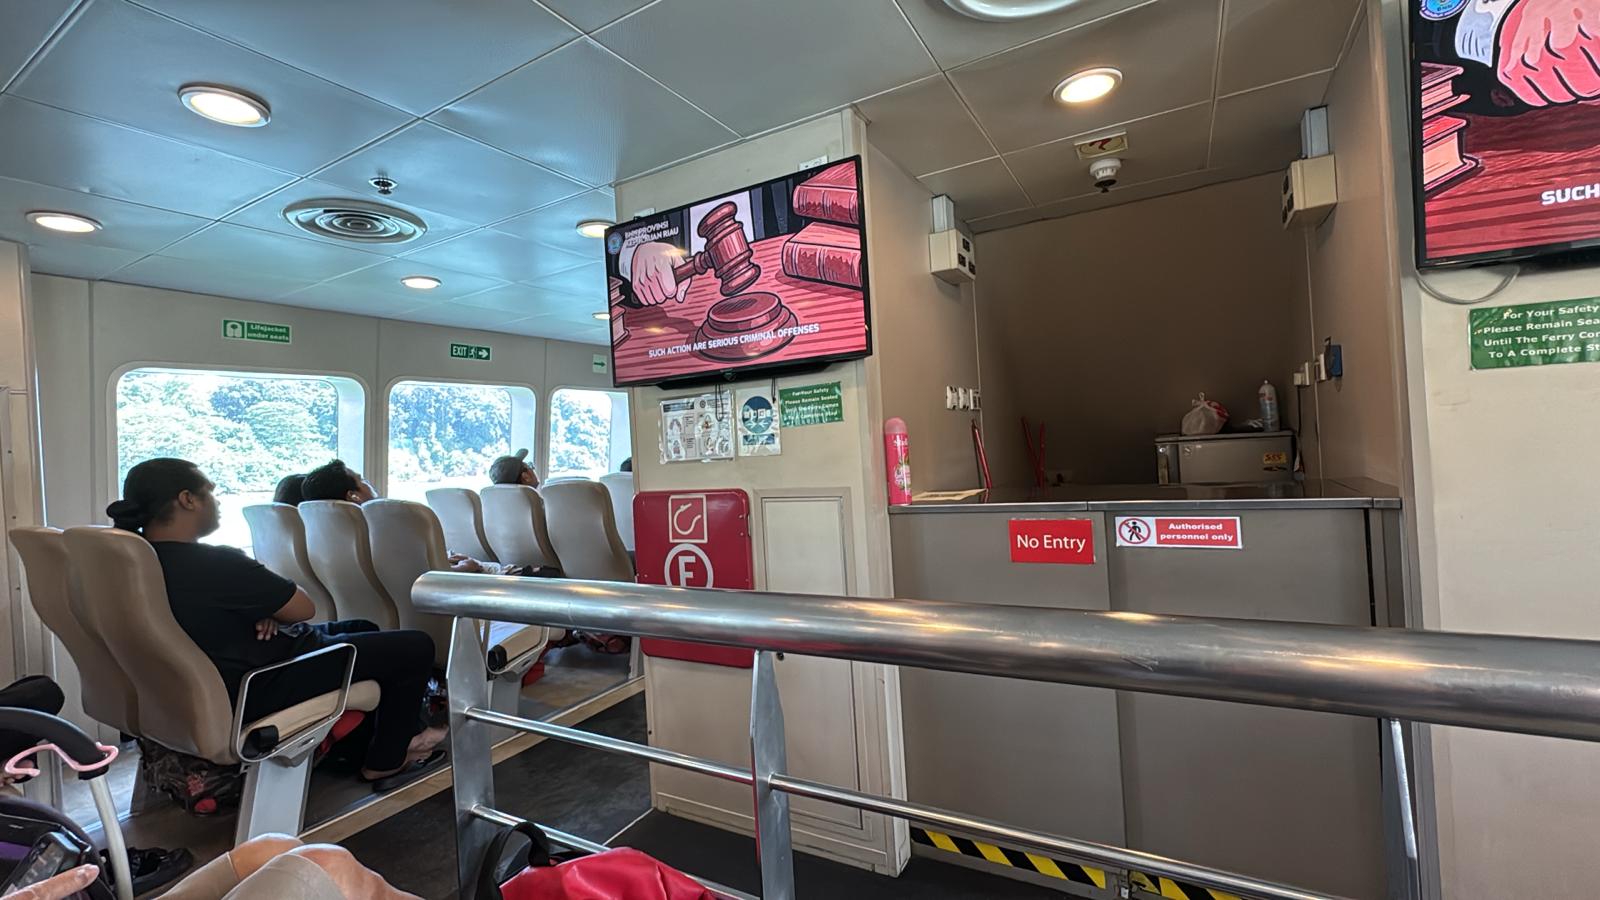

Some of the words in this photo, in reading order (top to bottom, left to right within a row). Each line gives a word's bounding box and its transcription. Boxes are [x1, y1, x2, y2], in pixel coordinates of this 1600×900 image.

[1541, 183, 1600, 206] SUCH
[662, 226, 679, 238] RIAU
[1503, 311, 1523, 320] For
[1526, 309, 1555, 318] Your
[1558, 304, 1600, 316] Safety
[1483, 324, 1523, 335] Please
[1526, 320, 1573, 331] Remain
[648, 347, 666, 358] SUCH
[667, 343, 692, 355] ACTION
[693, 341, 707, 351] ARE
[708, 336, 739, 349] SERIOUS
[739, 331, 776, 344] CRIMINAL
[778, 323, 820, 337] OFFENSES
[1483, 338, 1512, 347] Until
[1516, 335, 1539, 345] The
[1541, 333, 1575, 343] Ferry
[452, 345, 468, 357] EXIT
[1488, 351, 1504, 359] To
[1507, 349, 1517, 358] A
[1520, 345, 1582, 357] Complete
[1016, 535, 1039, 549] No
[1043, 535, 1086, 553] Entry
[1160, 533, 1208, 541] personnel
[1211, 533, 1233, 542] only
[678, 555, 696, 588] F
